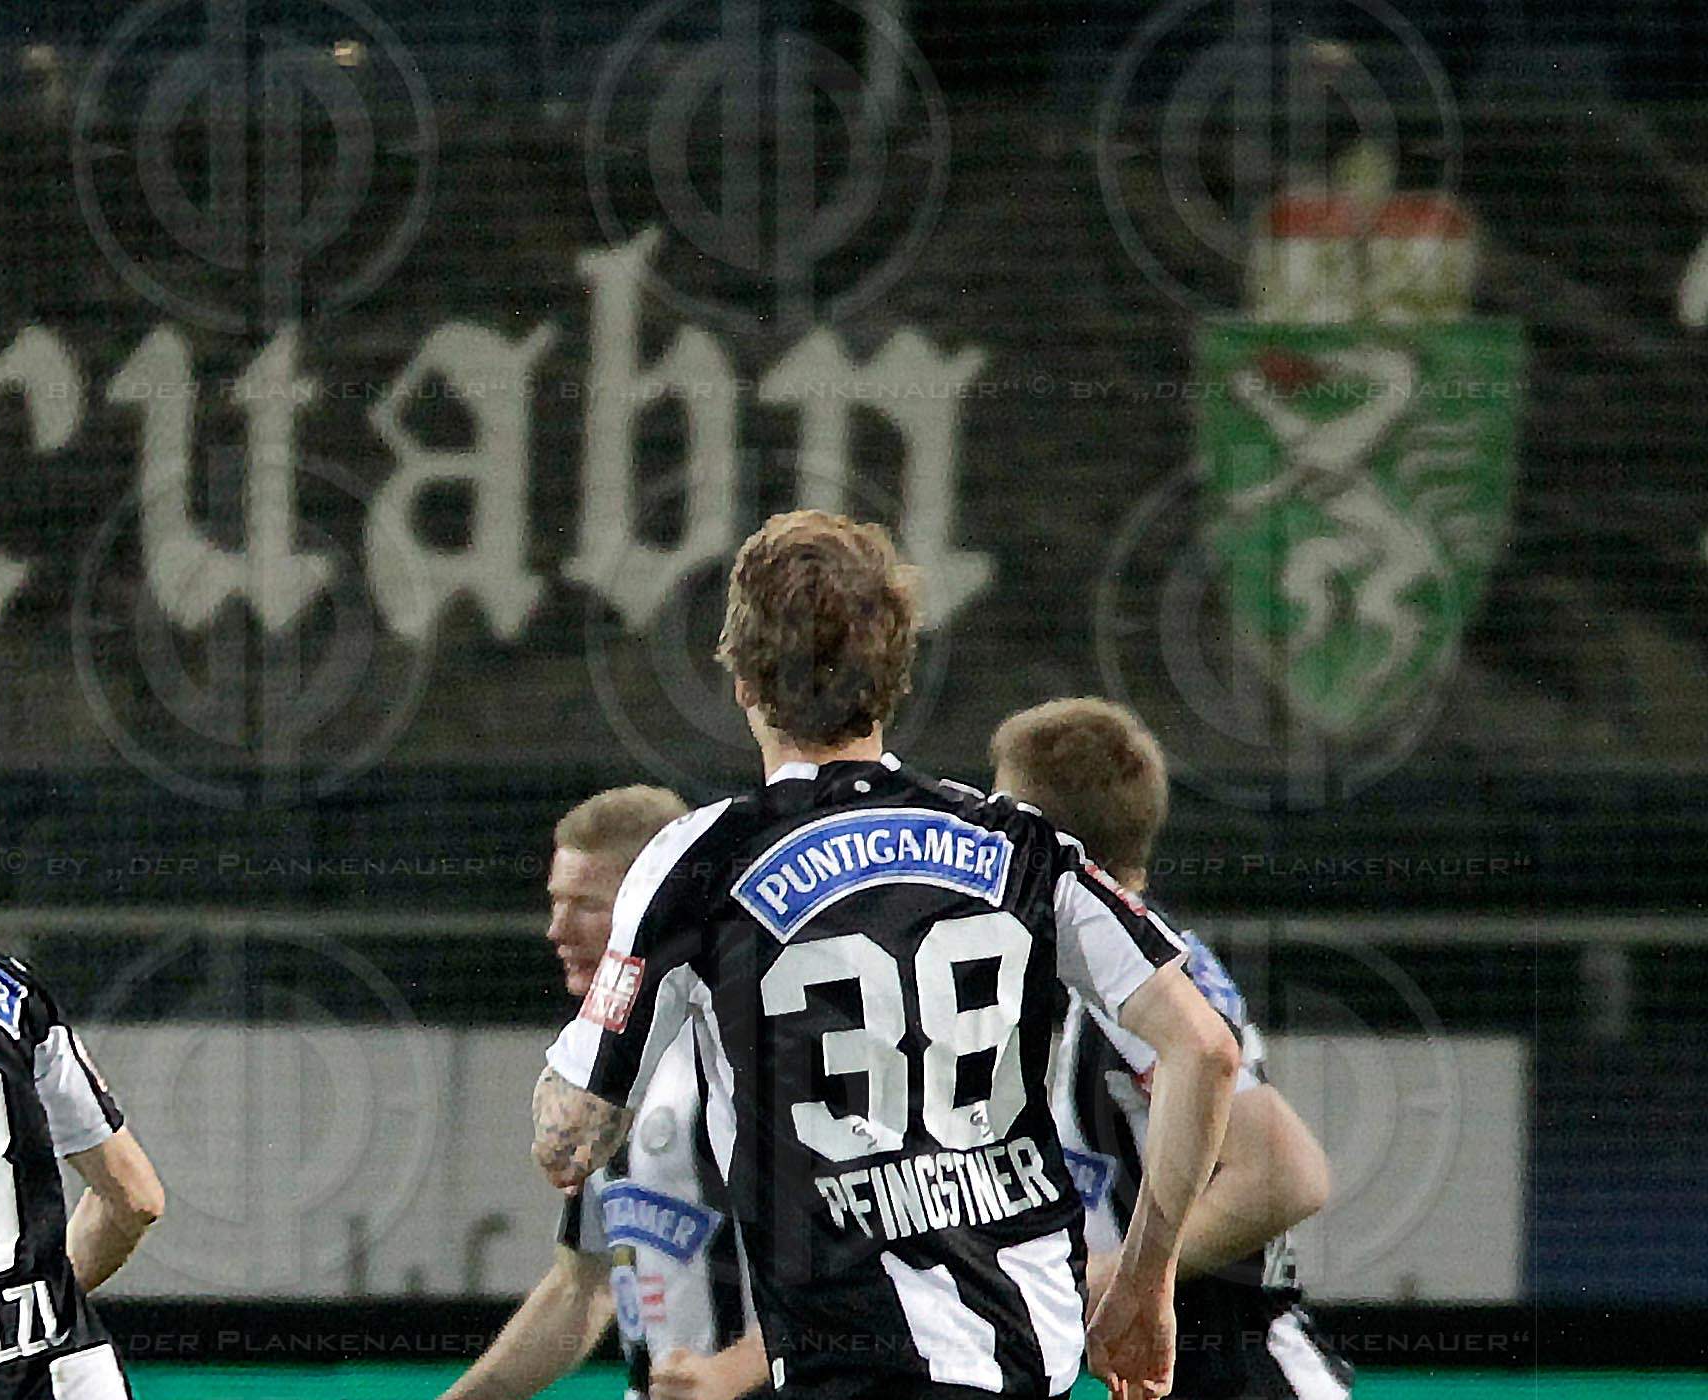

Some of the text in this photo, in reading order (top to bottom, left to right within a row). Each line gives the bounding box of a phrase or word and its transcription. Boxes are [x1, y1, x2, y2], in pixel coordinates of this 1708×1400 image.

[758, 822, 1000, 920] PUNTIGAMER
[761, 912, 1034, 1163] 38
[815, 1137, 1060, 1242] PFINGSTNER
